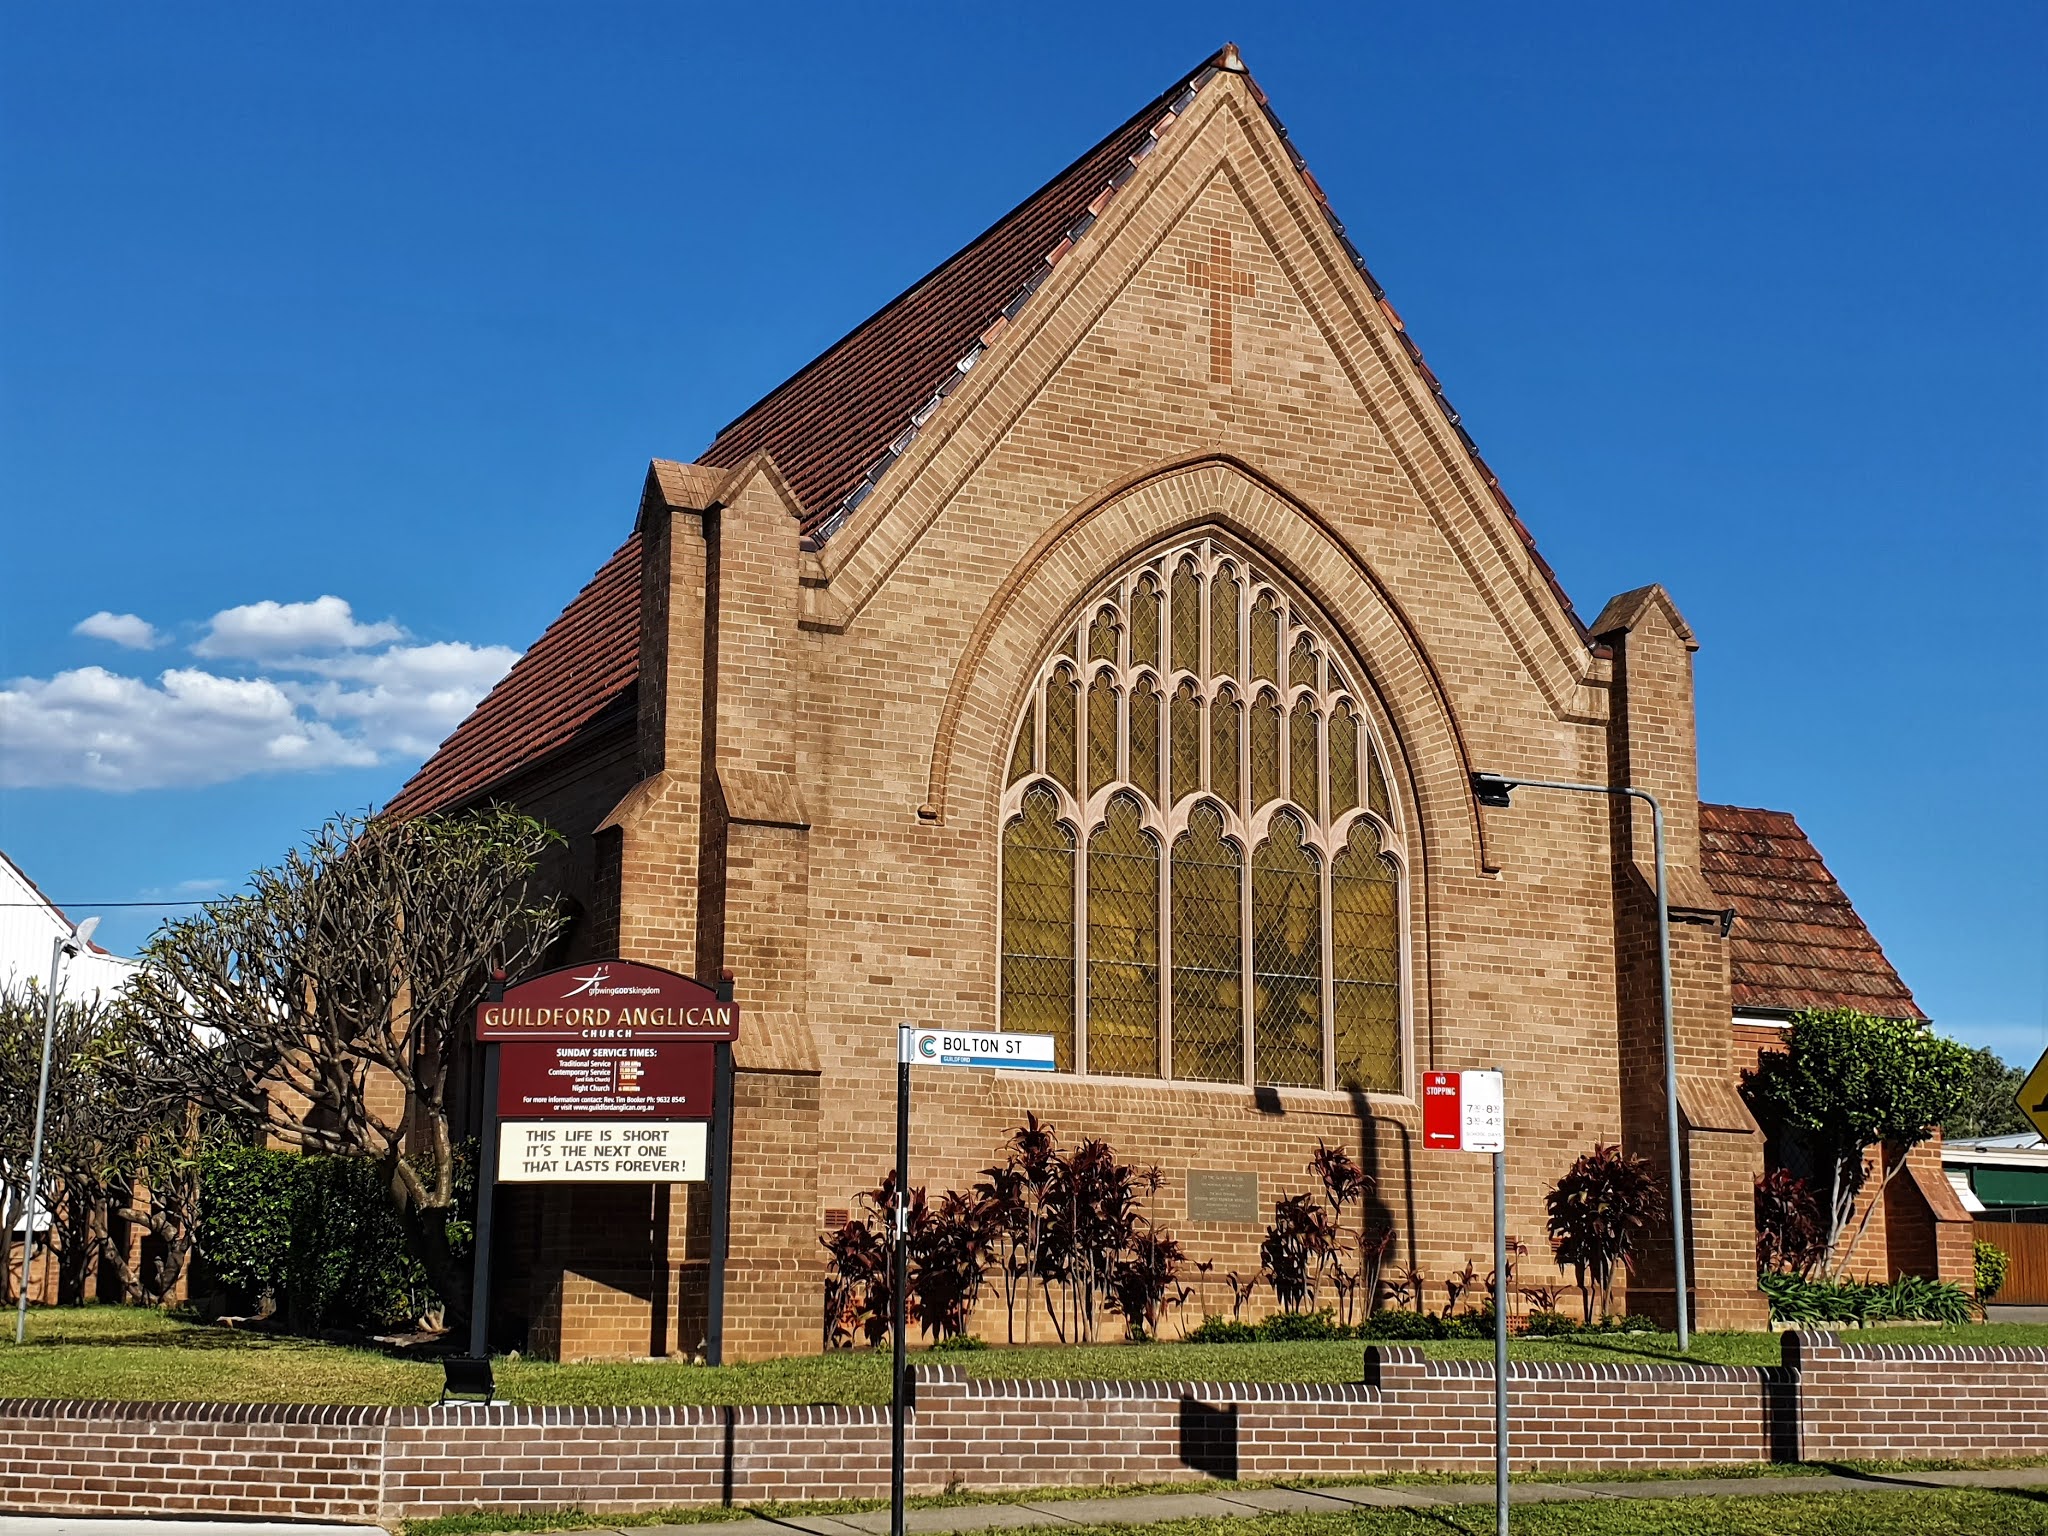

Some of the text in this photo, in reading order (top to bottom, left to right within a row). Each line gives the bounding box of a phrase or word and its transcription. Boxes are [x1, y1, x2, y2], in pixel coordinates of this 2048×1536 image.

[484, 1007, 732, 1027] GUILDFORD ANGLICAN
[581, 1029, 632, 1038] CHURCH
[943, 1037, 1022, 1054] BOLTON ST
[556, 1048, 658, 1057] SUNDAY SERVICE TIMES:
[548, 1068, 589, 1077] Contemporary
[590, 1068, 611, 1076] Service
[1435, 1076, 1446, 1085] NO
[572, 1085, 588, 1093] Night
[1426, 1086, 1456, 1096] STOPPING
[573, 1104, 655, 1112] www.guildfordanglican.org.au
[526, 1130, 670, 1142] THIS LIFE IS SHORT
[526, 1144, 667, 1157] IT'S THE NEXT ONE
[522, 1160, 686, 1173] THAT LASTS FOREVER!
